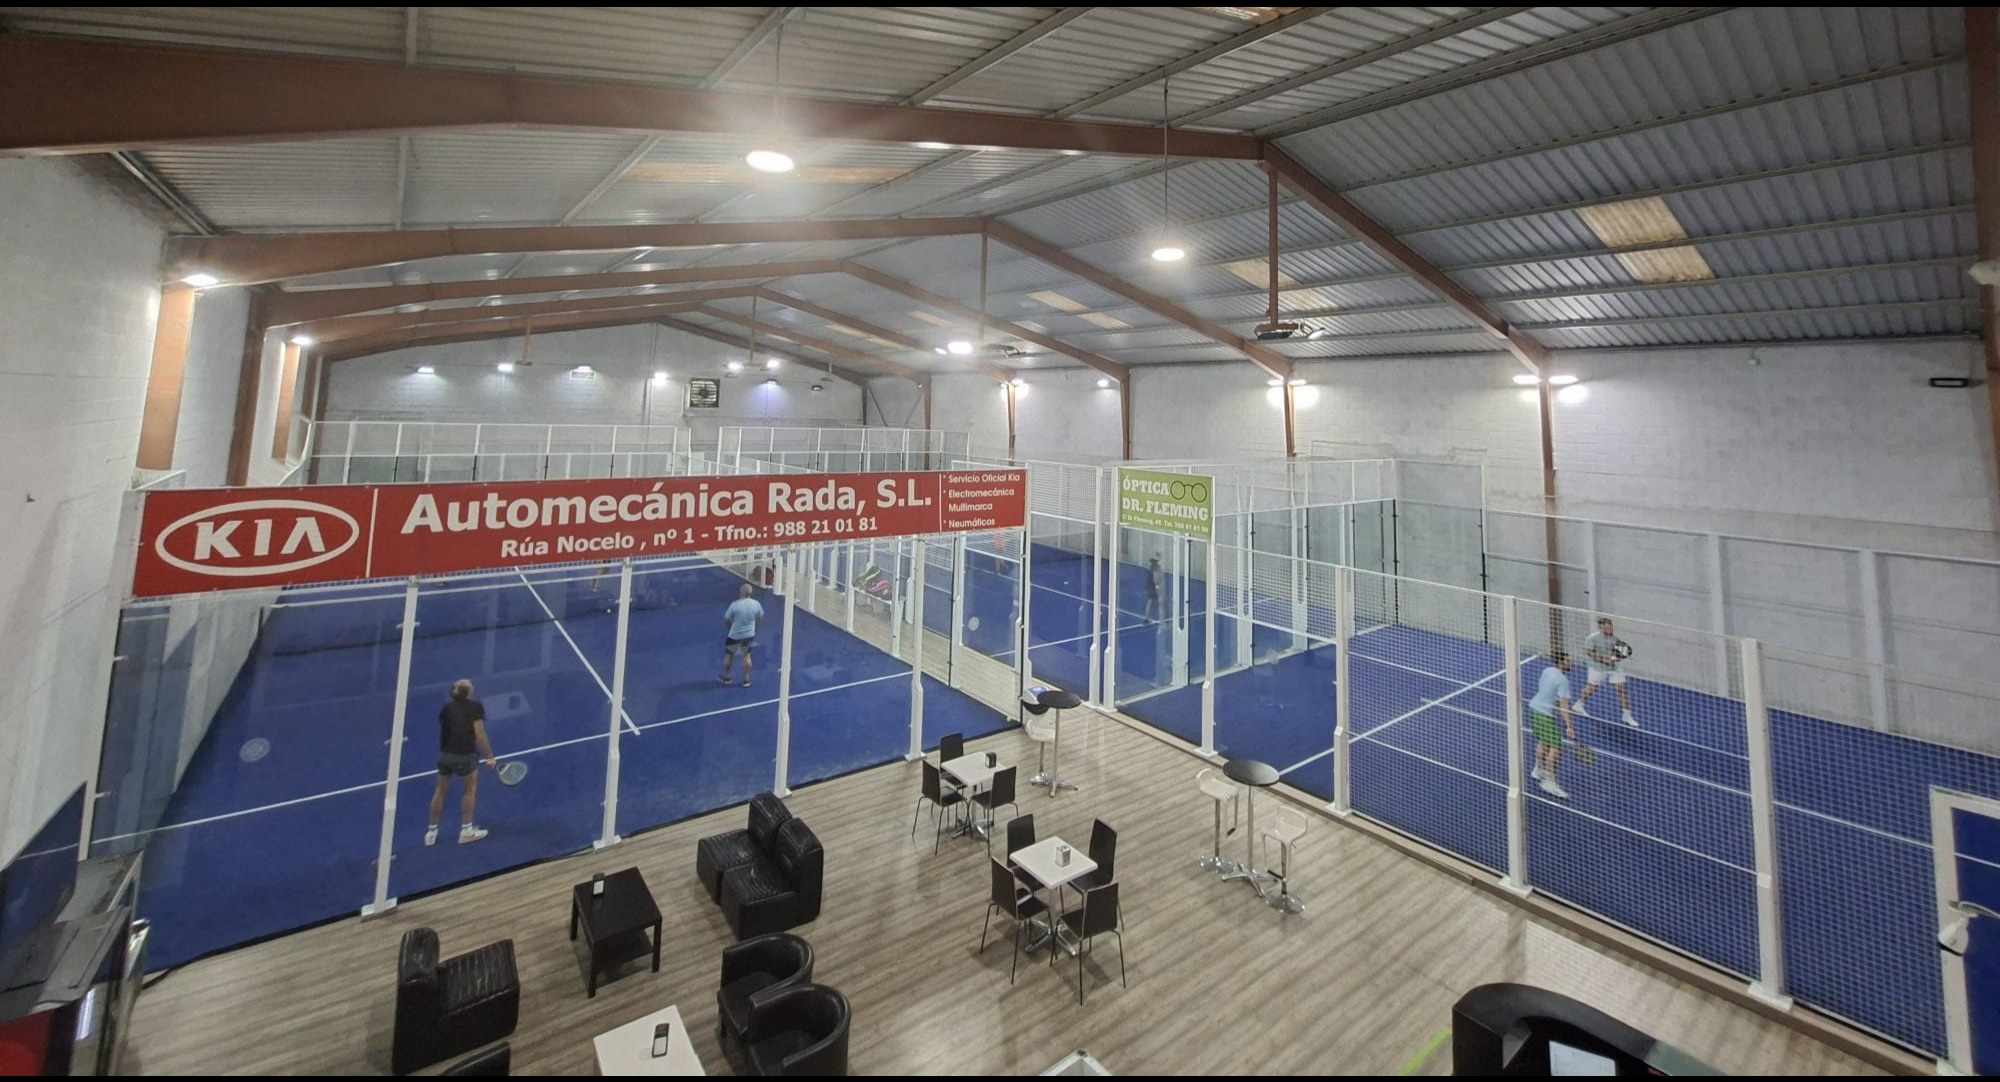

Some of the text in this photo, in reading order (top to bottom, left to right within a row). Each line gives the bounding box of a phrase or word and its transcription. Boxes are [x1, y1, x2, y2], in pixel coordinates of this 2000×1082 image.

[948, 473, 1020, 484] Servicio Oficial Kia
[1122, 475, 1169, 496] ÓPTICA
[948, 487, 1015, 499] Electromecánica
[400, 478, 932, 534] Automecánica Rada, S.L.
[948, 502, 993, 513] Multimarca
[1122, 497, 1209, 521] DR. FLEMING
[948, 517, 996, 528] Neumáticos
[193, 516, 326, 560] KIA
[501, 536, 549, 557] Rúa
[557, 531, 635, 554] Nocelo
[653, 529, 678, 546] nº
[684, 528, 695, 543] 1
[715, 524, 768, 543] Tfno.:
[774, 521, 806, 538] 988
[812, 519, 831, 535] 21
[836, 518, 854, 534] 01
[859, 516, 878, 532] 81
